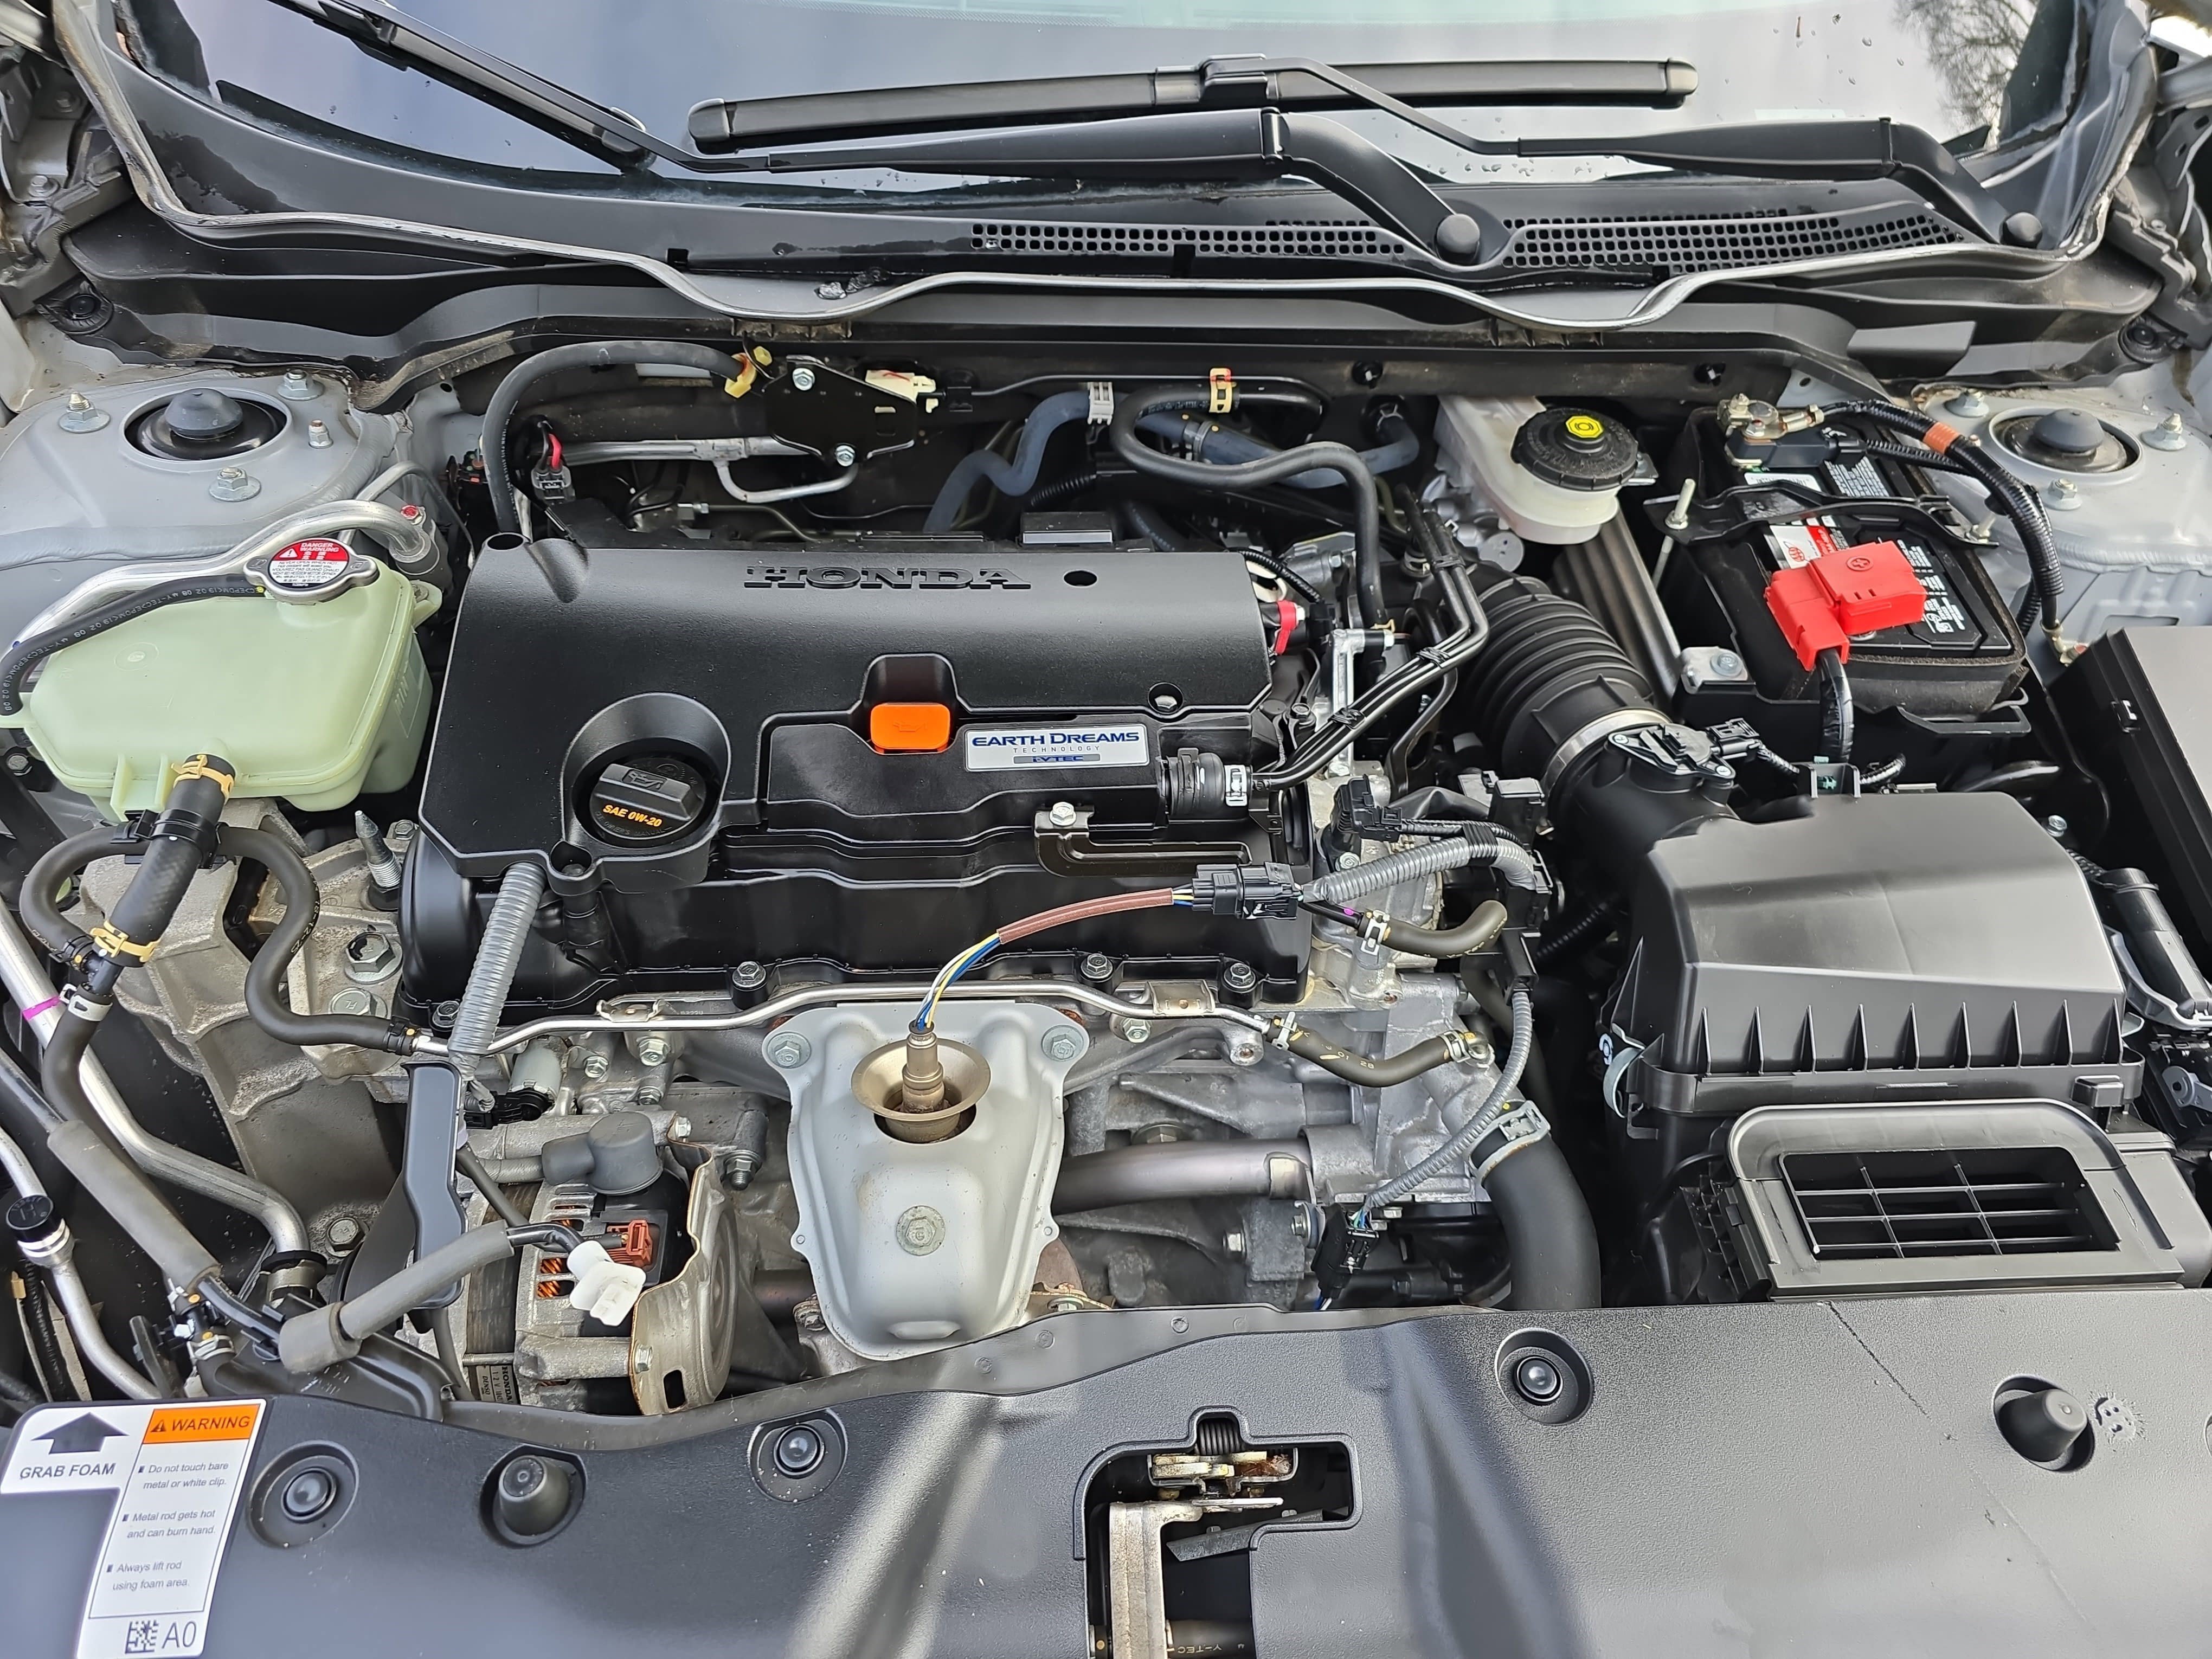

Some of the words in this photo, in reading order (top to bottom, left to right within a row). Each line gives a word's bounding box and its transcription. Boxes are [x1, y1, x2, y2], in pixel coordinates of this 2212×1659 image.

[744, 565, 1031, 589] HONDA
[972, 732, 1046, 747] EARTH
[1050, 731, 1140, 744] DREAMS
[1013, 745, 1101, 753] TECHNOLOGY
[602, 804, 627, 818] SAE
[627, 808, 663, 827] 0W-20
[604, 821, 630, 835] OWNER'S
[483, 1375, 491, 1395] DENSO
[502, 1366, 512, 1401] HONDA
[171, 1416, 250, 1431] WARNING
[20, 1464, 65, 1480] GRAB
[68, 1462, 116, 1477] FOAM
[149, 1464, 160, 1473] Do
[162, 1464, 179, 1472] not
[181, 1462, 207, 1472] touch
[208, 1462, 229, 1471] bare
[143, 1480, 169, 1489] metal
[183, 1478, 207, 1488] white
[209, 1477, 227, 1488] clip.
[132, 1512, 159, 1522] Metal
[160, 1512, 176, 1521] rod
[177, 1511, 198, 1522] gets
[200, 1509, 216, 1519] hot
[127, 1528, 146, 1538] and
[166, 1527, 188, 1536] burn
[190, 1526, 216, 1535] hand.
[116, 1563, 151, 1574] Always
[152, 1561, 164, 1571] lift
[166, 1561, 182, 1570] rod
[113, 1581, 138, 1592] using
[140, 1579, 164, 1590] foam
[166, 1578, 190, 1588] area.
[162, 1621, 196, 1649] A0
